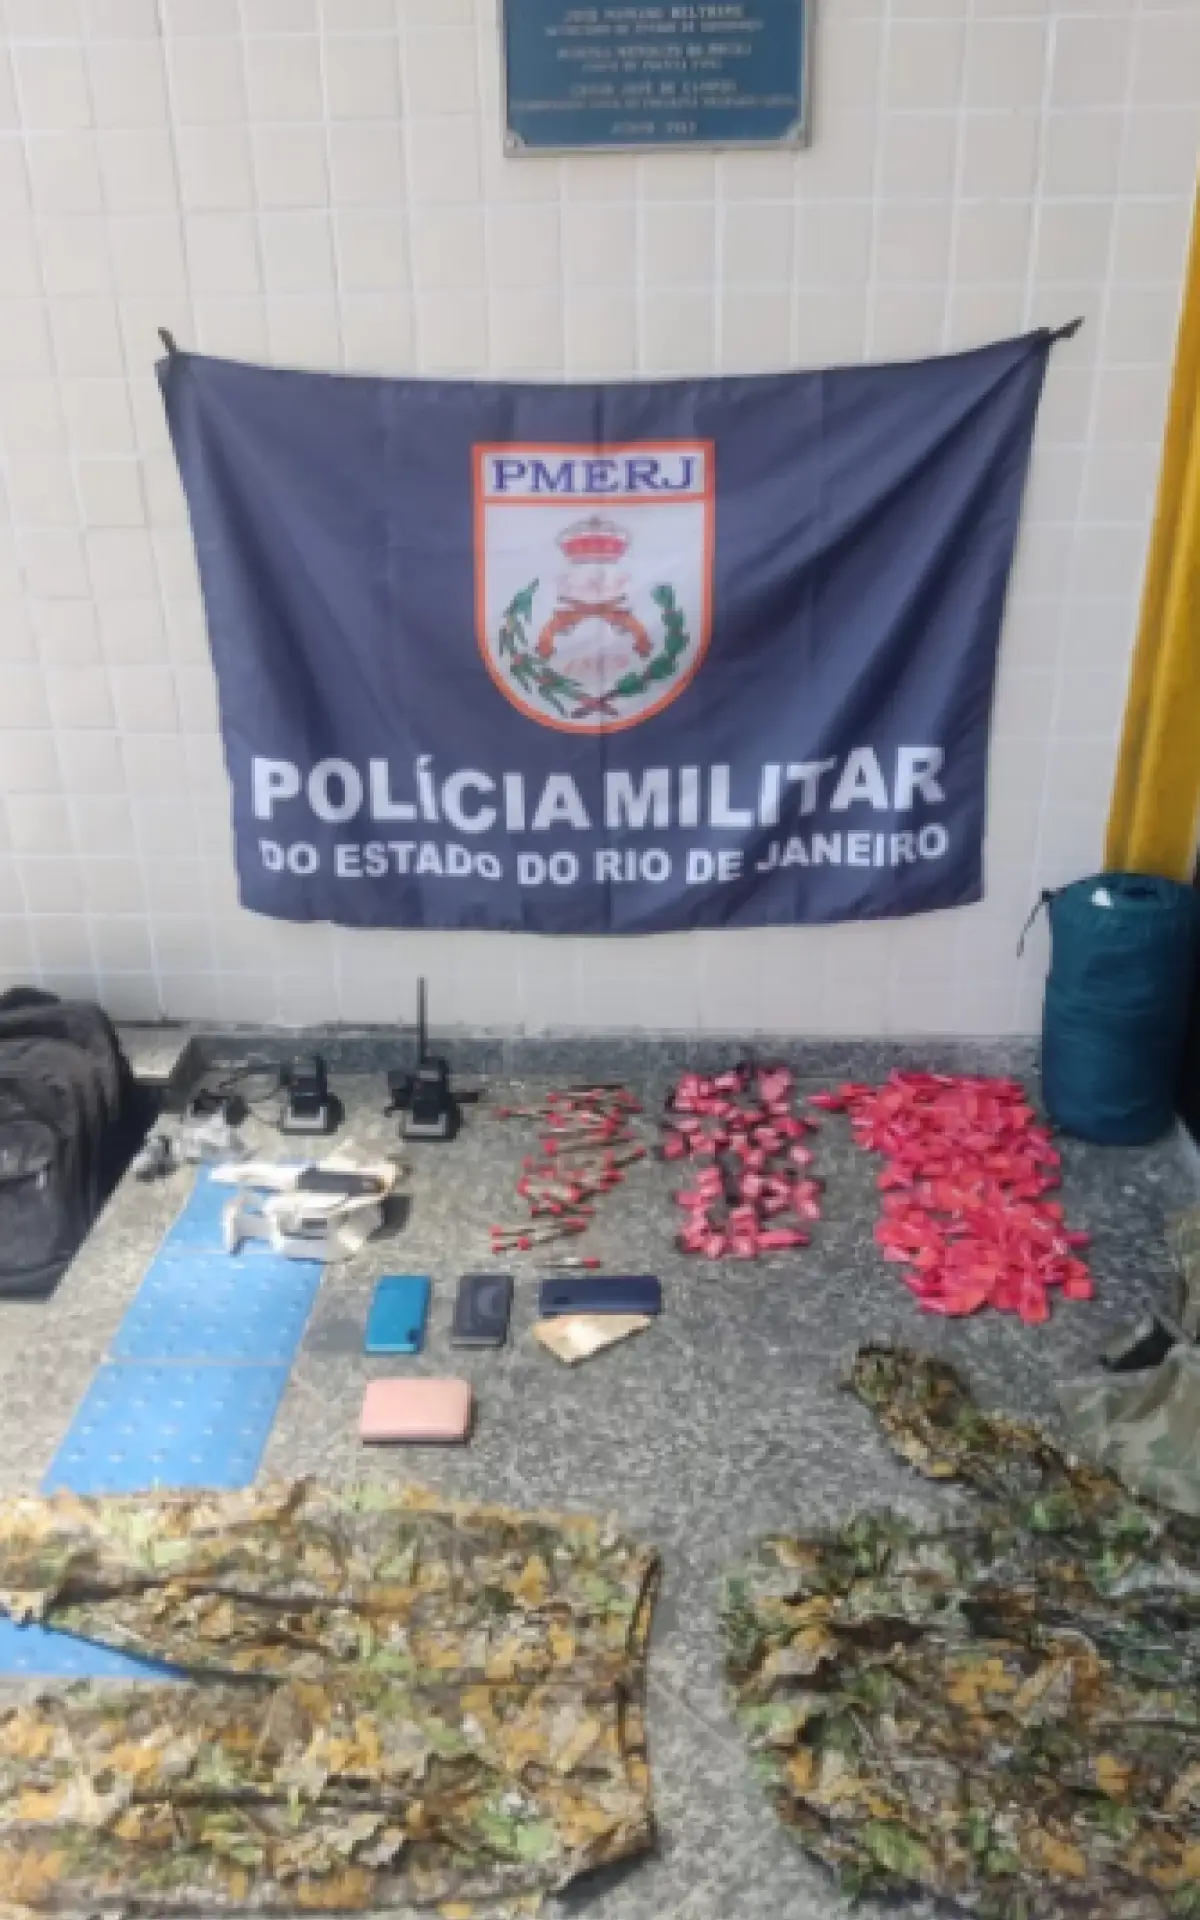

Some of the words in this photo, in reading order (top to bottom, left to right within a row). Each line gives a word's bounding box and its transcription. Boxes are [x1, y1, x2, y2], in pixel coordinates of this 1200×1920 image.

[491, 456, 696, 493] PMERJ
[252, 754, 593, 833] POLÍCIA
[603, 744, 946, 830] MILITAR
[258, 837, 319, 874] DO
[333, 840, 503, 880] ESTADO
[517, 850, 580, 886] DO
[595, 848, 673, 885] RIO
[685, 848, 745, 885] DE
[755, 822, 950, 874] JANEIRO
